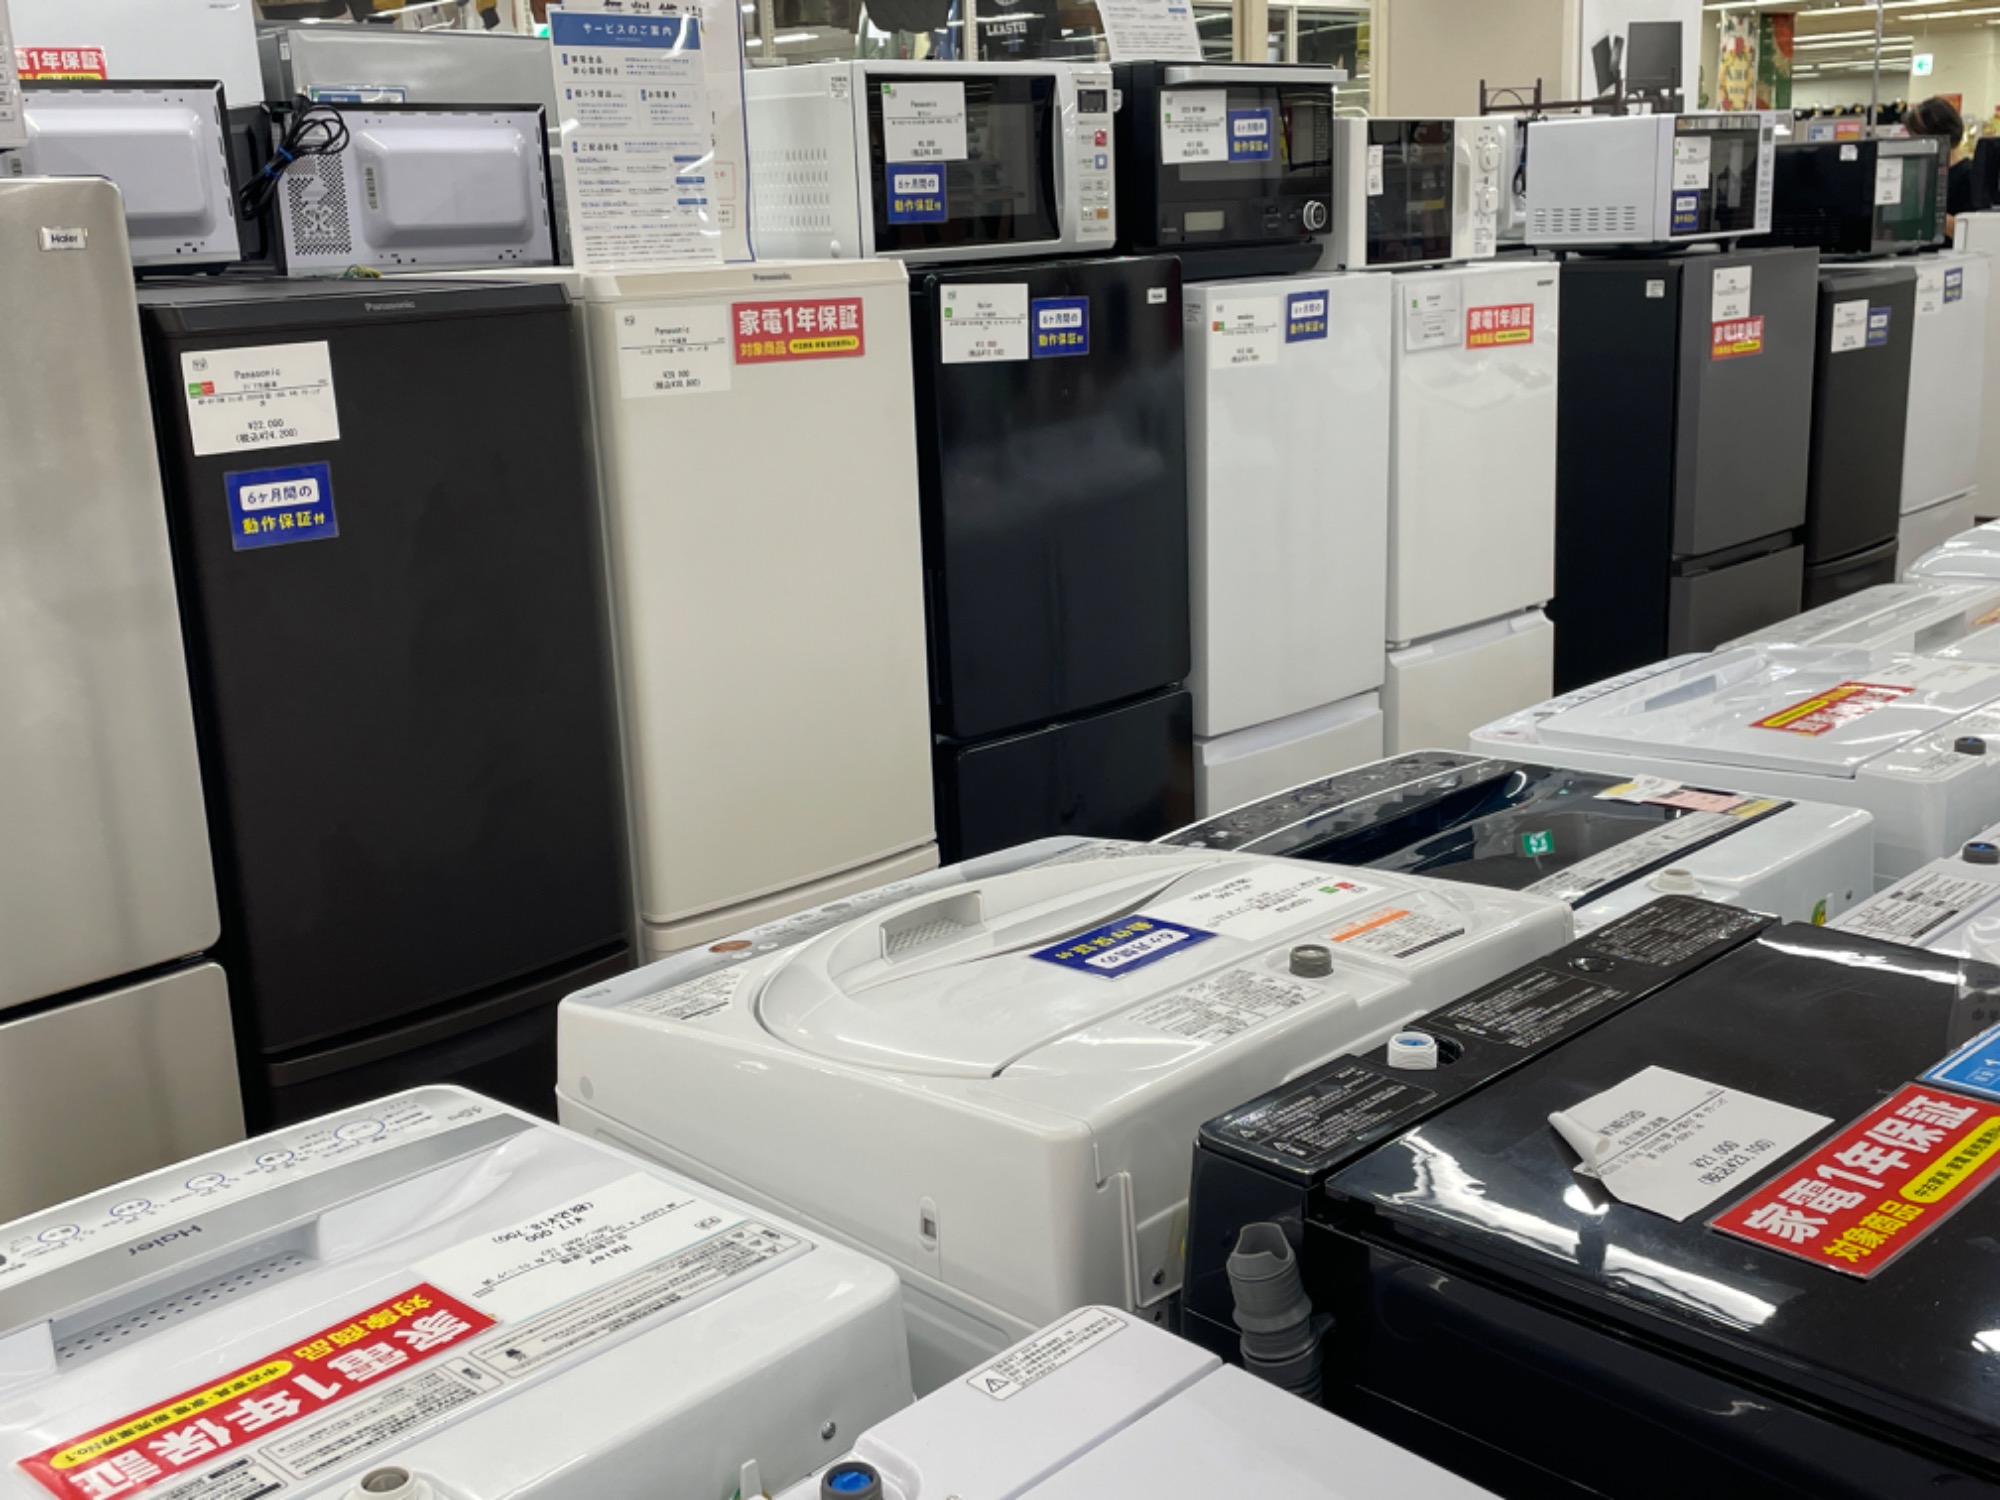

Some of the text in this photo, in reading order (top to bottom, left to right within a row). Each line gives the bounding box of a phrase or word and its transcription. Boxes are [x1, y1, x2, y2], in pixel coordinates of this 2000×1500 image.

[739, 304, 859, 336] 家電1年保証
[234, 368, 281, 379] Panasonic
[241, 511, 326, 534] 動作保証付
[1742, 1094, 1978, 1244] 家電1年保証
[128, 1224, 202, 1256] Haier
[1822, 1199, 1925, 1262] 対象商品
[589, 1243, 633, 1266] Haier
[293, 1294, 434, 1361] 対象商品
[67, 1308, 472, 1500] 家電1年保証
